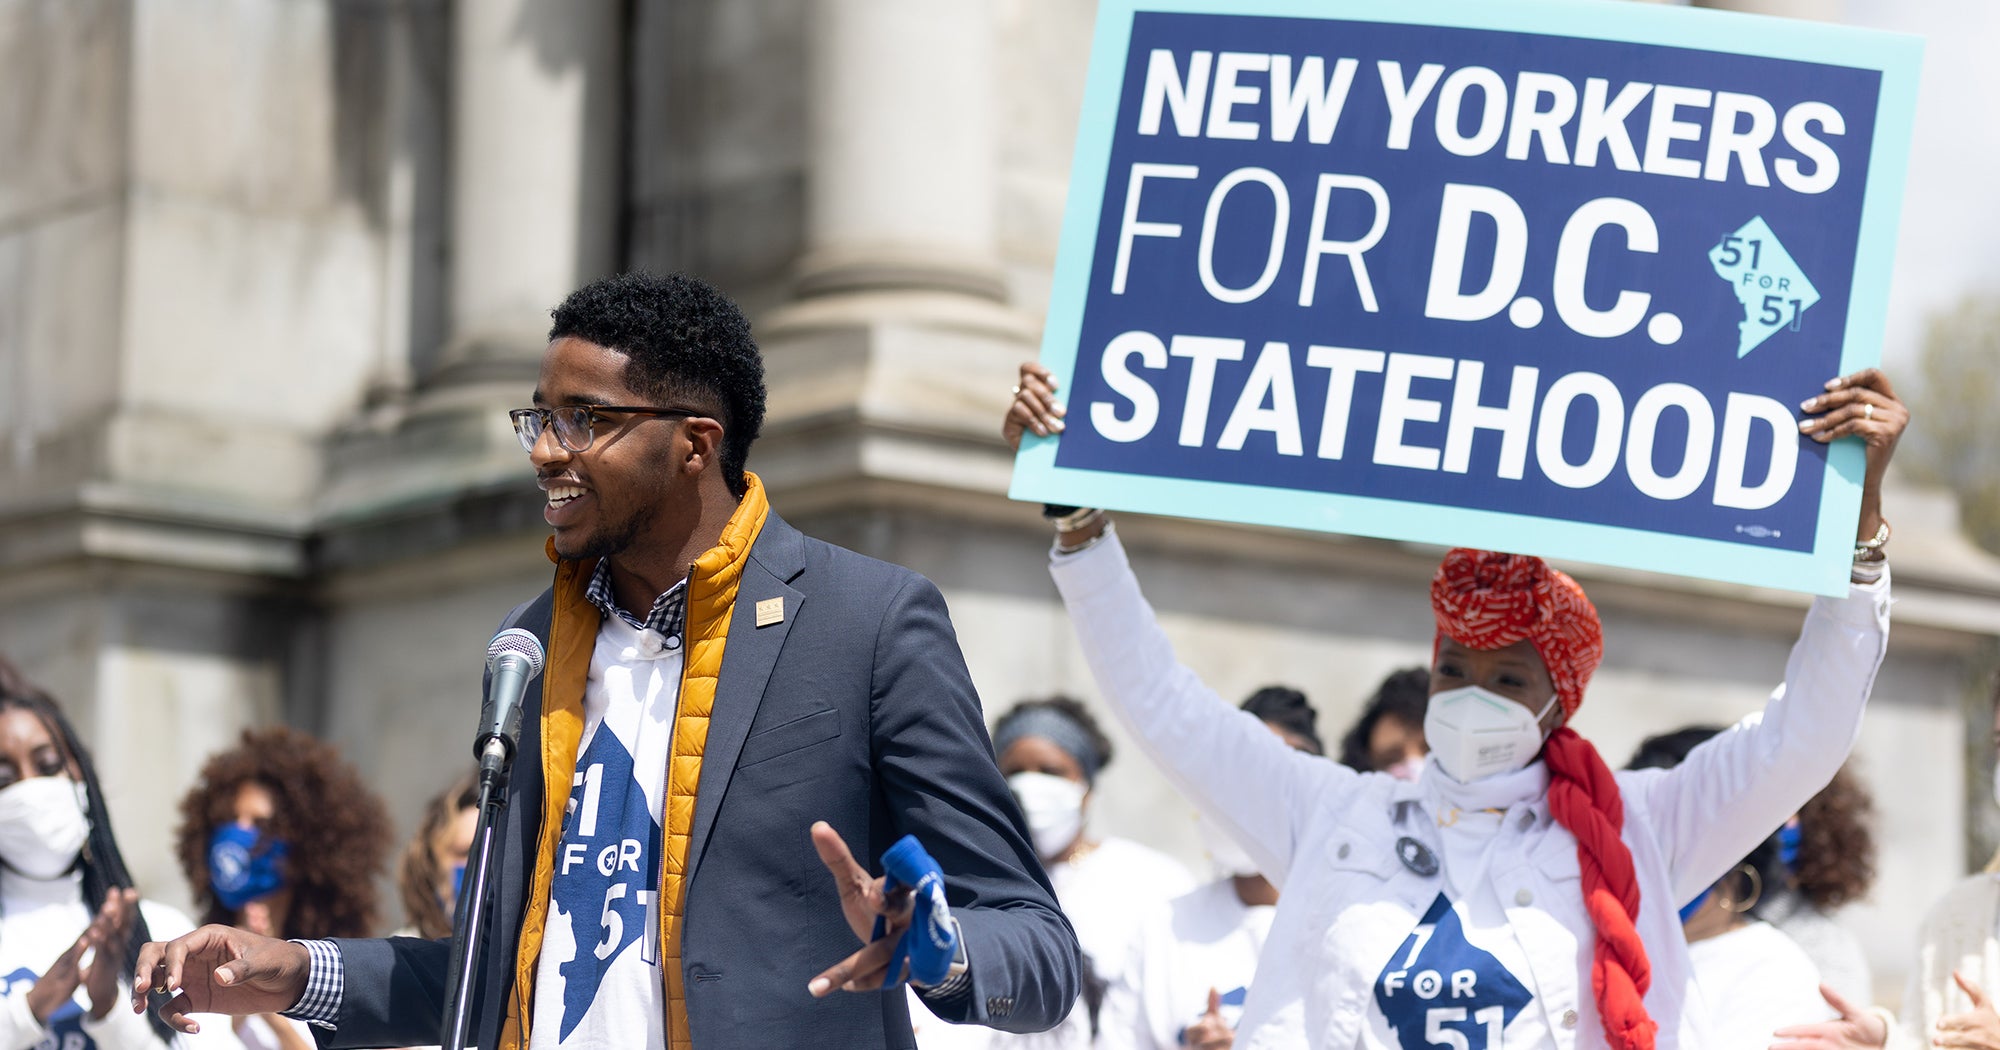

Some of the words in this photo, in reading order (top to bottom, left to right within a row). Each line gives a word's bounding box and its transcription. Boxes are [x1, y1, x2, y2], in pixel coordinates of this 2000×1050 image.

[1138, 49, 1359, 146] NEW
[1377, 61, 1847, 195] YORKERS
[1111, 163, 1391, 313] FOR
[1424, 183, 1684, 346] D.C.
[1719, 236, 1761, 270] 51
[1743, 272, 1791, 293] FOR
[1759, 295, 1802, 331] 51
[1090, 330, 1800, 511] STATEHOOD
[561, 839, 642, 877] FOR
[594, 884, 661, 966] 51
[1384, 969, 1478, 1000] FOR
[1425, 1006, 1505, 1050] 51
